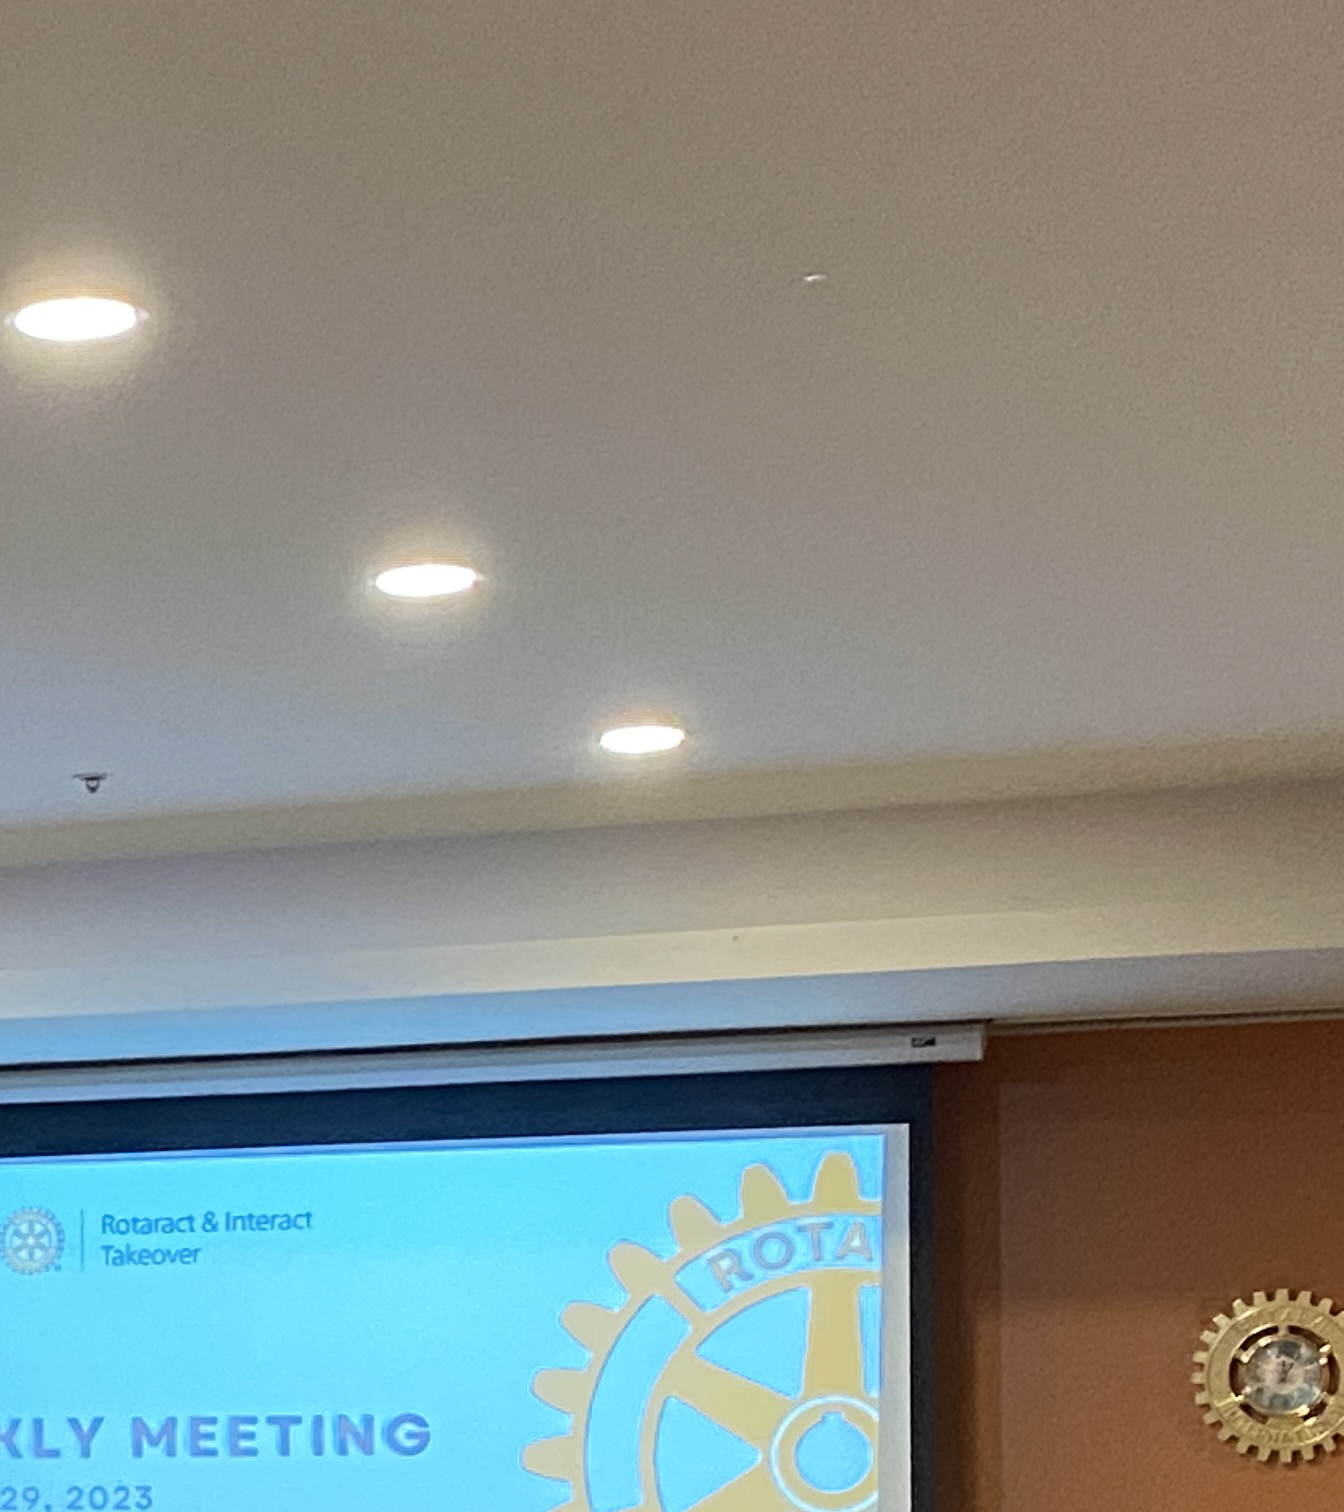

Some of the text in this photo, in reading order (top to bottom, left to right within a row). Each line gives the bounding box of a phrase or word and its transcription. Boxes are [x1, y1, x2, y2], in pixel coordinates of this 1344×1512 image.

[101, 1210, 314, 1236] Rotaract & Interact
[100, 1244, 202, 1267] Takeover
[706, 1219, 874, 1294] ROTA
[131, 1411, 433, 1458] MEETING
[65, 1484, 154, 1511] 2023
